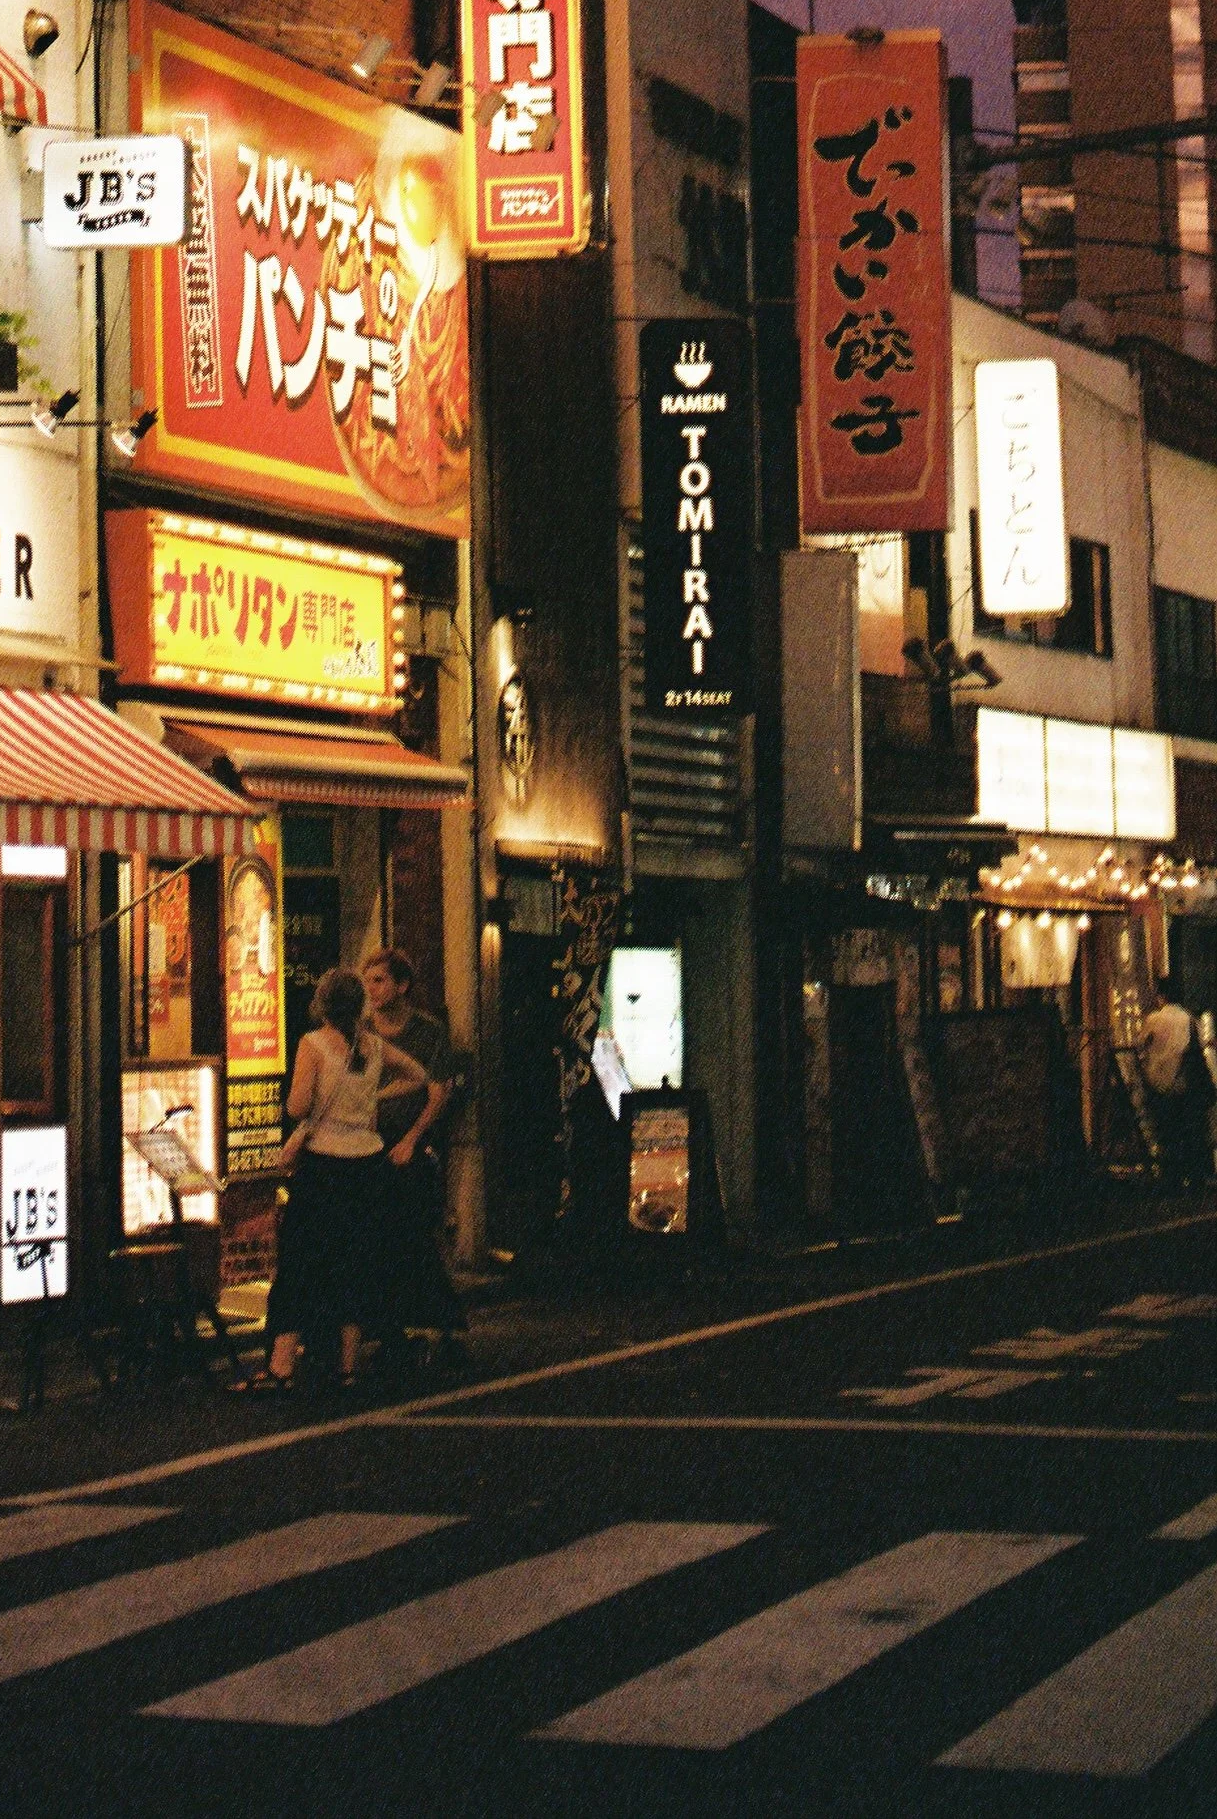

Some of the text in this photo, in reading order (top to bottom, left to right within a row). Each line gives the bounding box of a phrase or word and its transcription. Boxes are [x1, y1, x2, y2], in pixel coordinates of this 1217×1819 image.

[63, 168, 157, 213] JB'S
[813, 104, 920, 456] でっかい餃子
[235, 248, 398, 428] パンチョ
[660, 392, 728, 415] RAMEN
[677, 425, 714, 675] TOMIRAI
